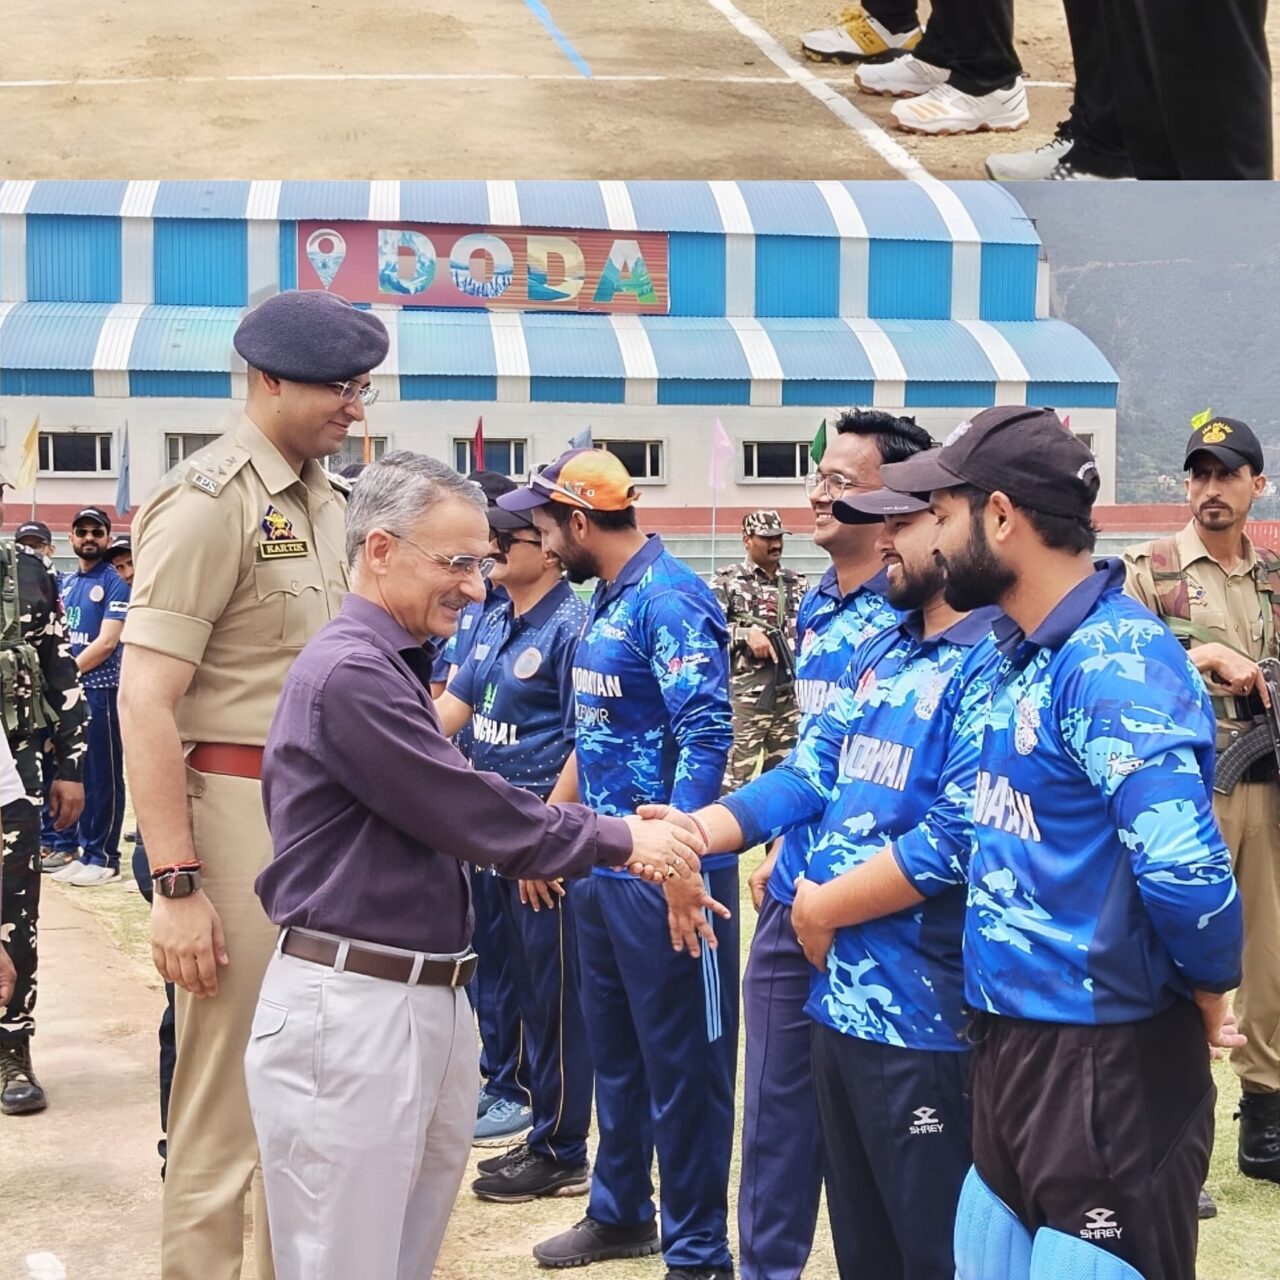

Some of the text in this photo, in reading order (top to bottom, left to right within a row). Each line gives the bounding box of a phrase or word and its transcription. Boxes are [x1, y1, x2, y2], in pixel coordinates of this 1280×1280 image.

[378, 228, 660, 305] DODA
[266, 543, 306, 554] KARTIK
[909, 1123, 945, 1135] SHREY
[1079, 1227, 1123, 1240] SHREY
